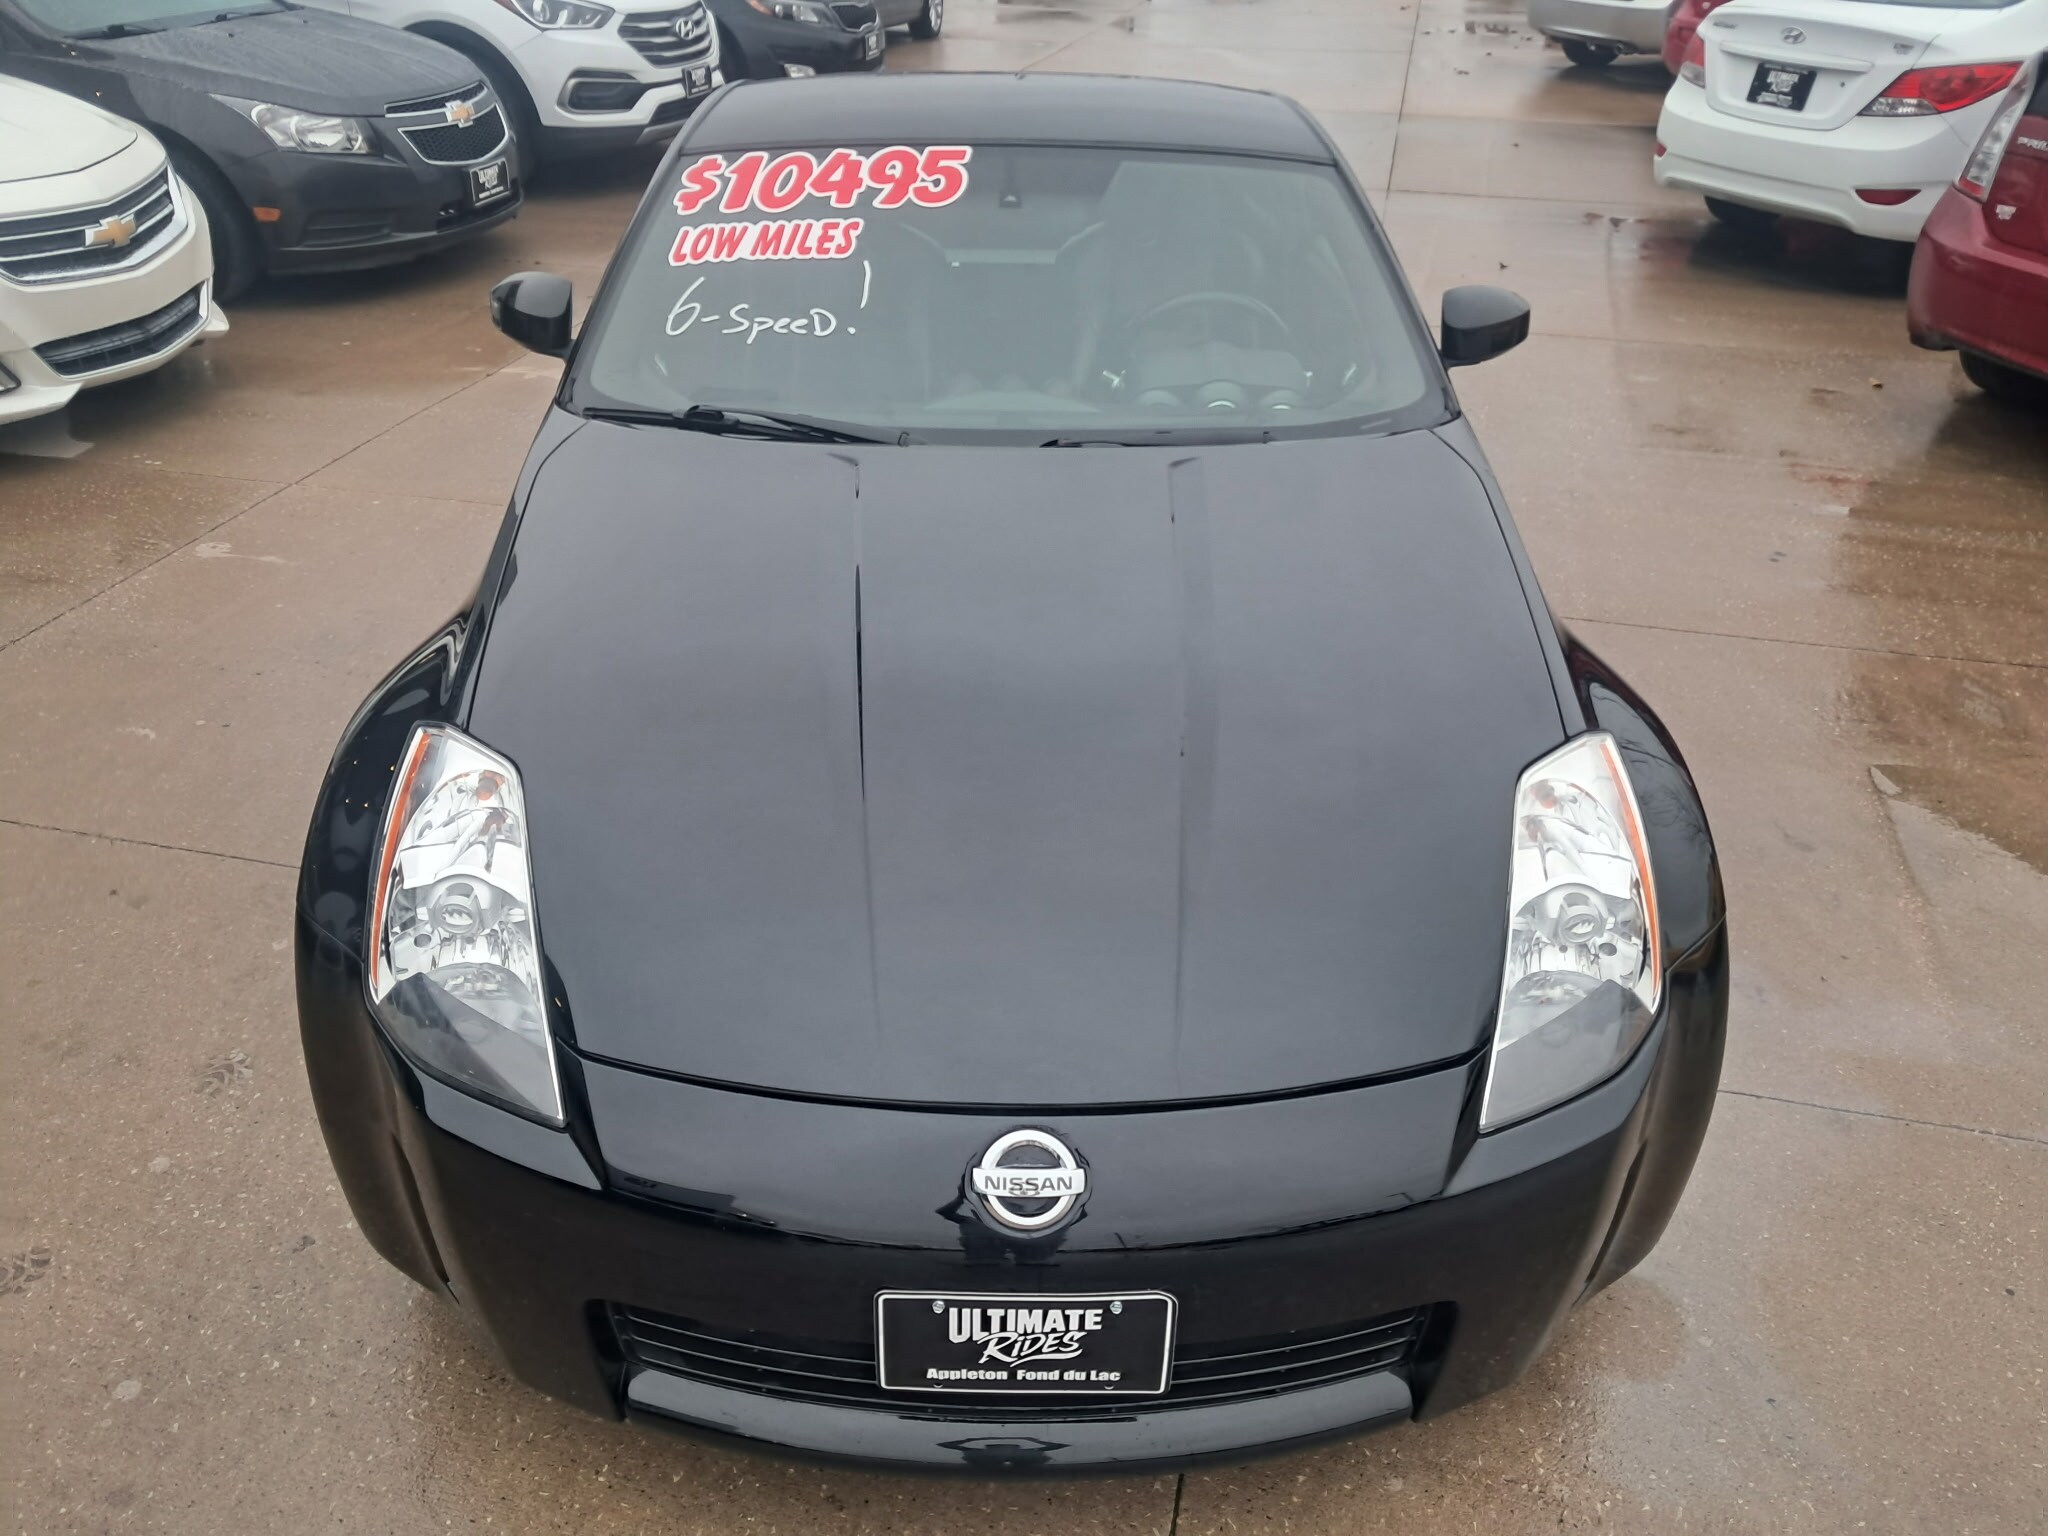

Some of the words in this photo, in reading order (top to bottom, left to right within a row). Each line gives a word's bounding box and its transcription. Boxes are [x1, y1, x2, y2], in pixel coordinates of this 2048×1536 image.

[673, 146, 973, 215] $10495
[669, 222, 748, 266] LOW
[749, 218, 864, 260] MILES
[984, 1175, 1073, 1191] NISSAN
[948, 1307, 1103, 1344] ULTIMATE
[926, 1368, 1008, 1381] Appleton
[1016, 1369, 1060, 1381] Fond
[1063, 1369, 1088, 1381] du
[1089, 1370, 1121, 1382] Lac
